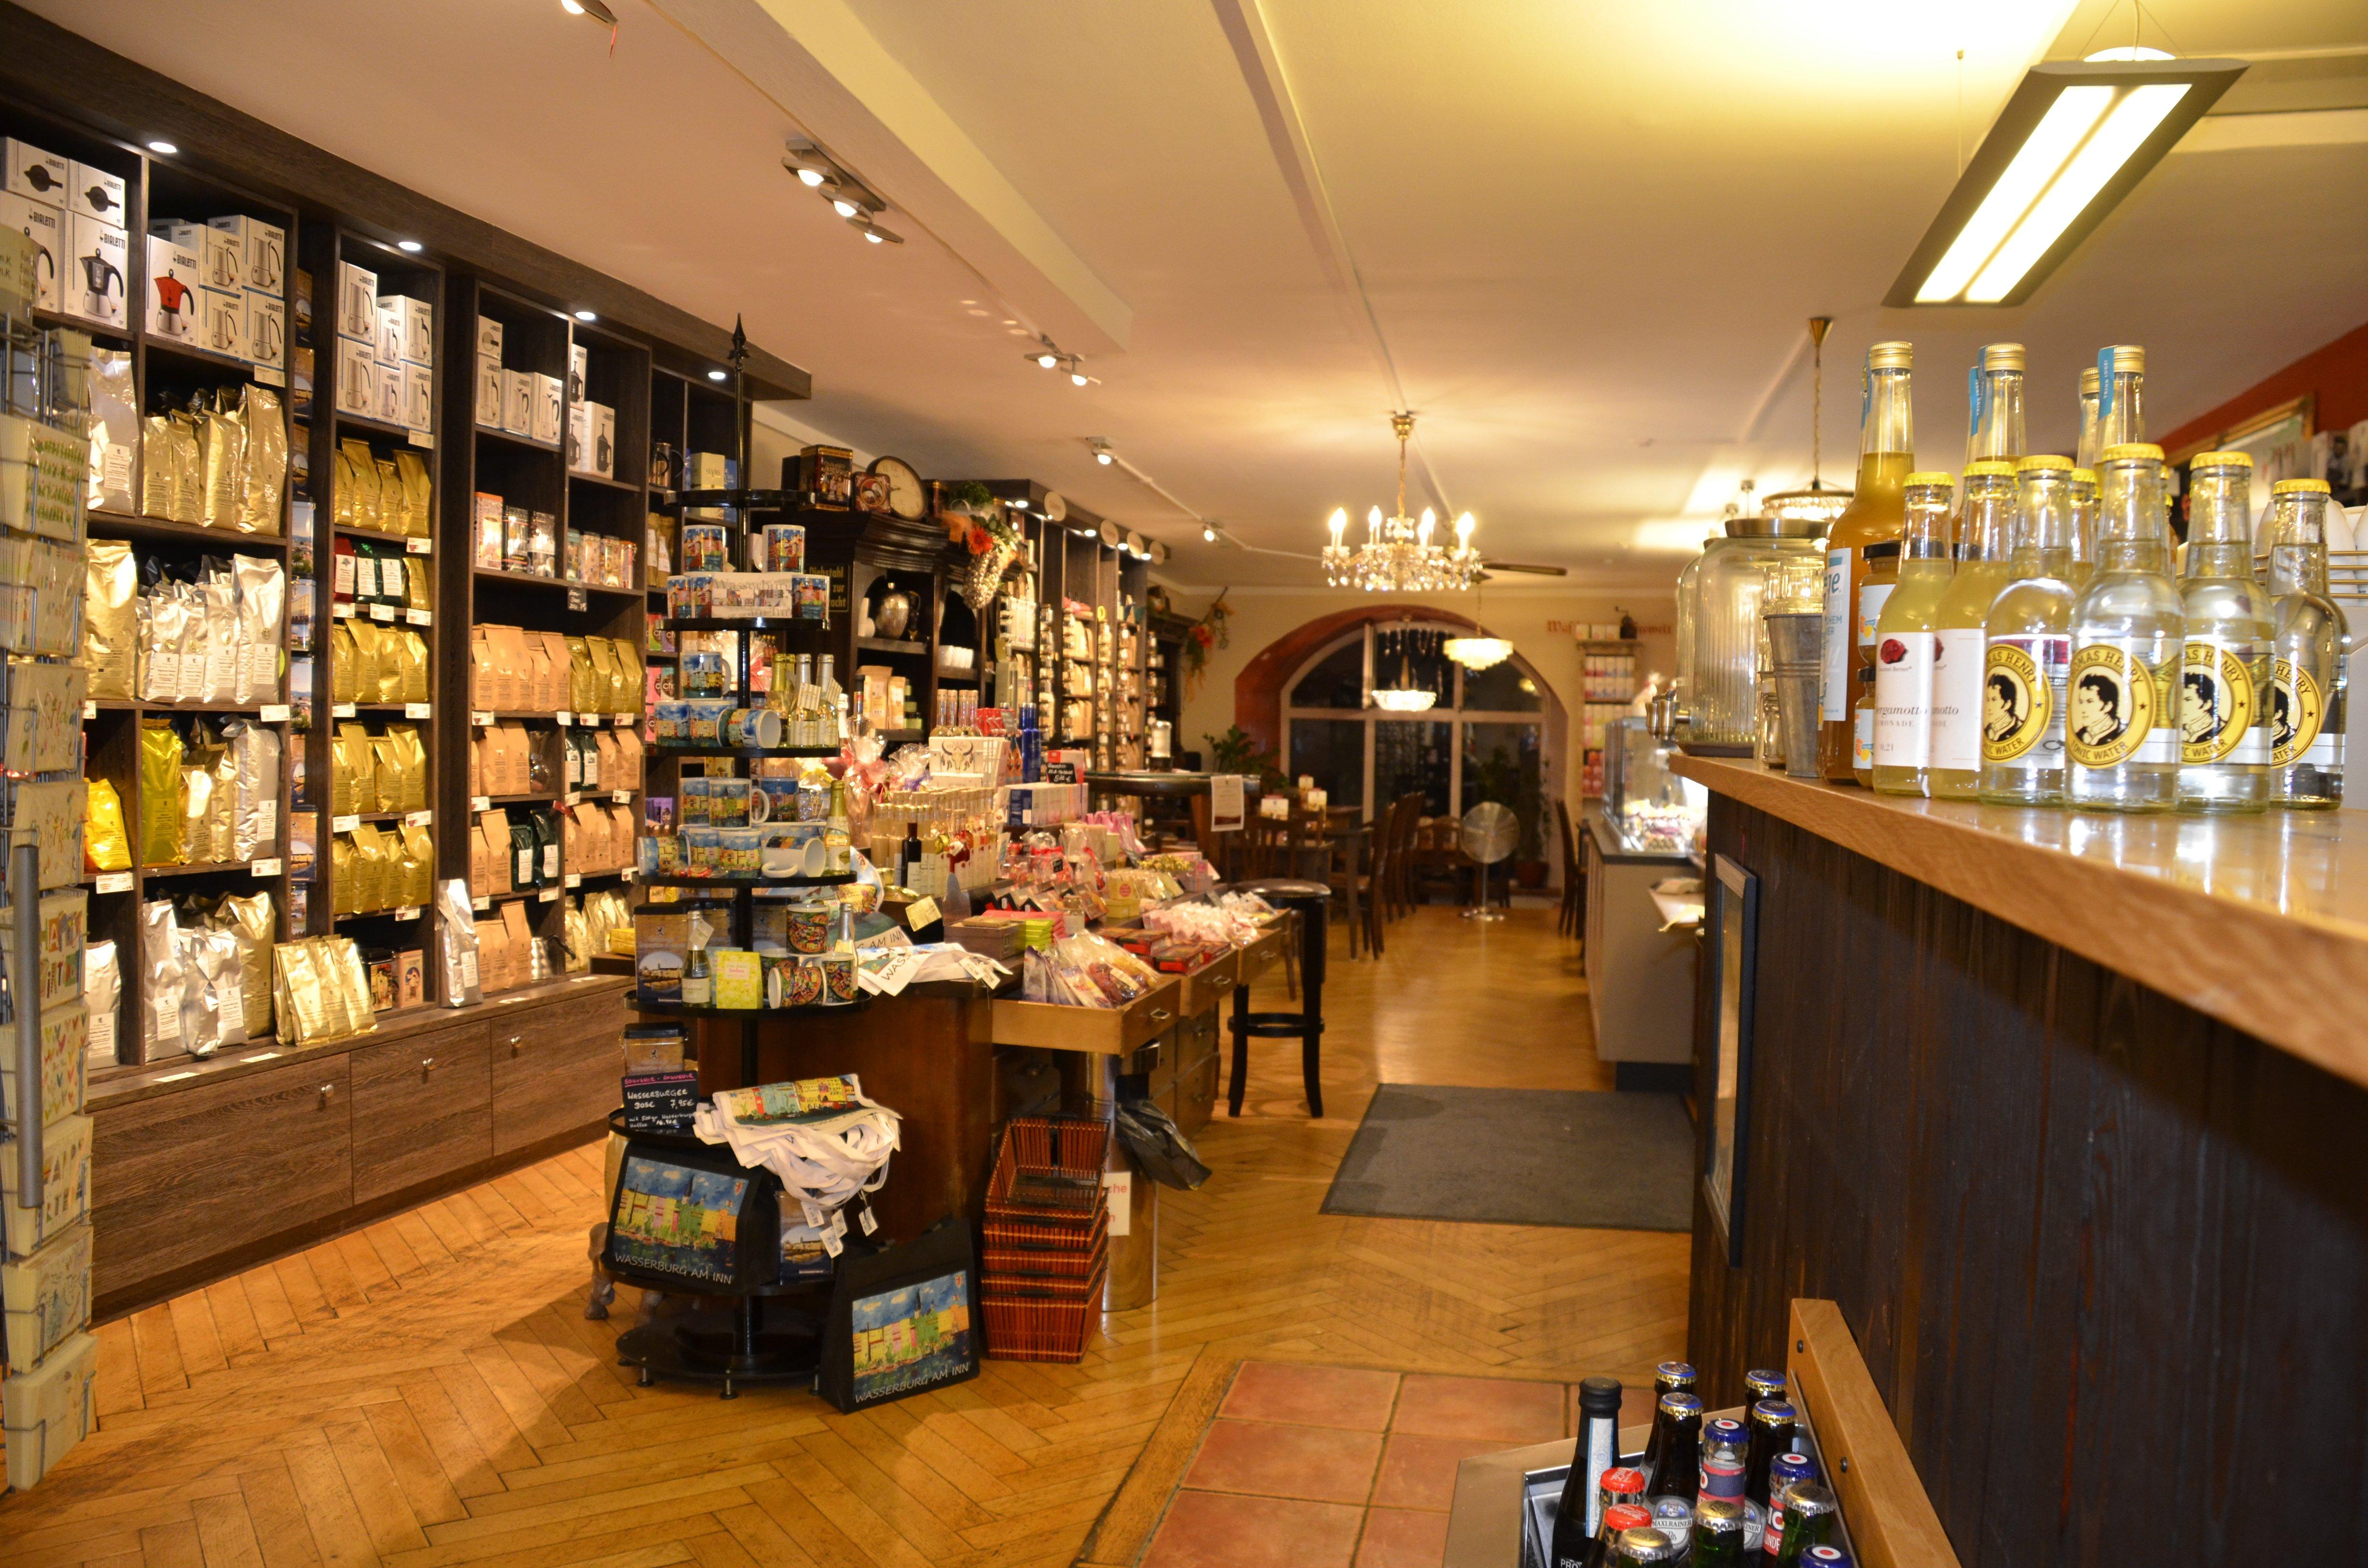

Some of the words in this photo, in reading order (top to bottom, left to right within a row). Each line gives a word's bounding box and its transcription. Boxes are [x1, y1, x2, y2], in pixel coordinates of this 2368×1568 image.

[830, 596, 846, 607] acht
[2005, 652, 2036, 684] HENRY
[2104, 651, 2144, 684] HERY
[2205, 649, 2243, 683] HNRY
[1996, 737, 2024, 755] WATER
[2094, 741, 2129, 760] WATER
[2273, 746, 2298, 761] ATER
[627, 1089, 688, 1100] WASSERBURGER
[615, 1253, 687, 1277] WASSERBURG
[691, 1267, 708, 1280] AM
[713, 1273, 732, 1285] INN
[855, 1375, 928, 1403] WASSERBURG
[931, 1369, 949, 1382] AM
[952, 1362, 969, 1376] INN
[1653, 1519, 1692, 1527] MAXLRAINER
